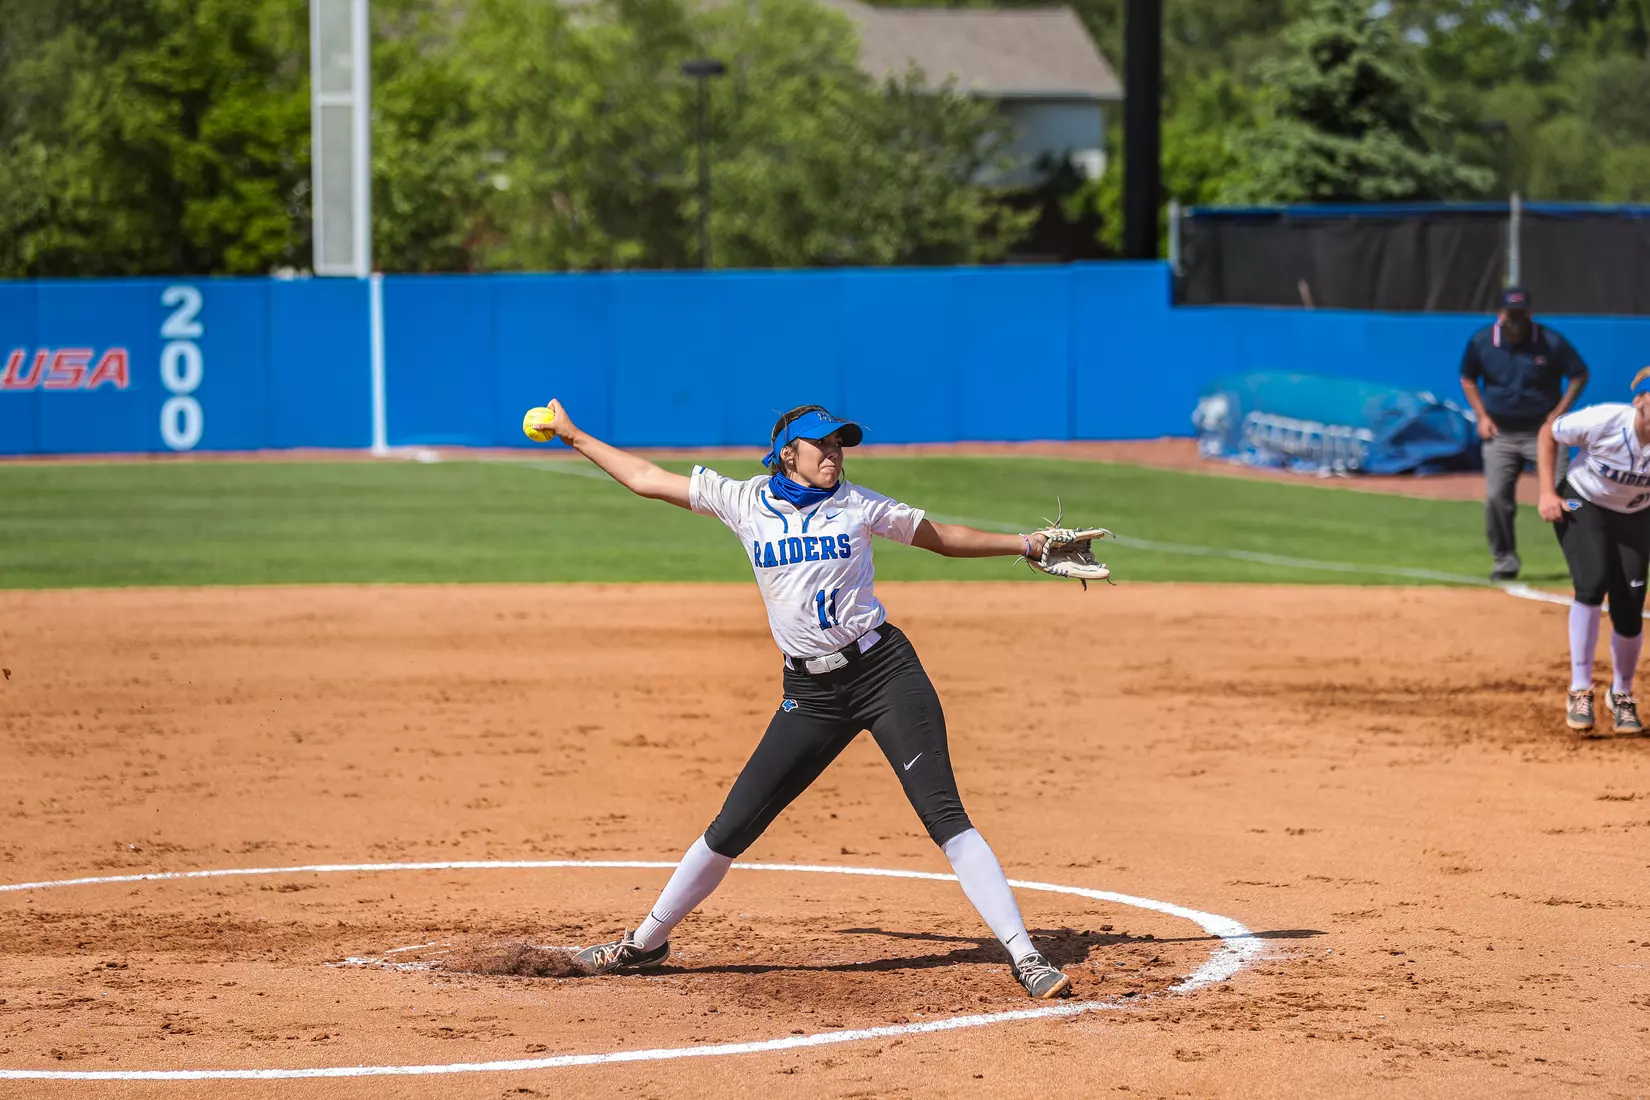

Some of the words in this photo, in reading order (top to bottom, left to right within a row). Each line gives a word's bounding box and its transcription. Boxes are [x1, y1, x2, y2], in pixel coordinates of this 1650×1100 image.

[1, 348, 129, 389] USA
[159, 284, 204, 451] 200
[754, 533, 851, 568] RAIDERS
